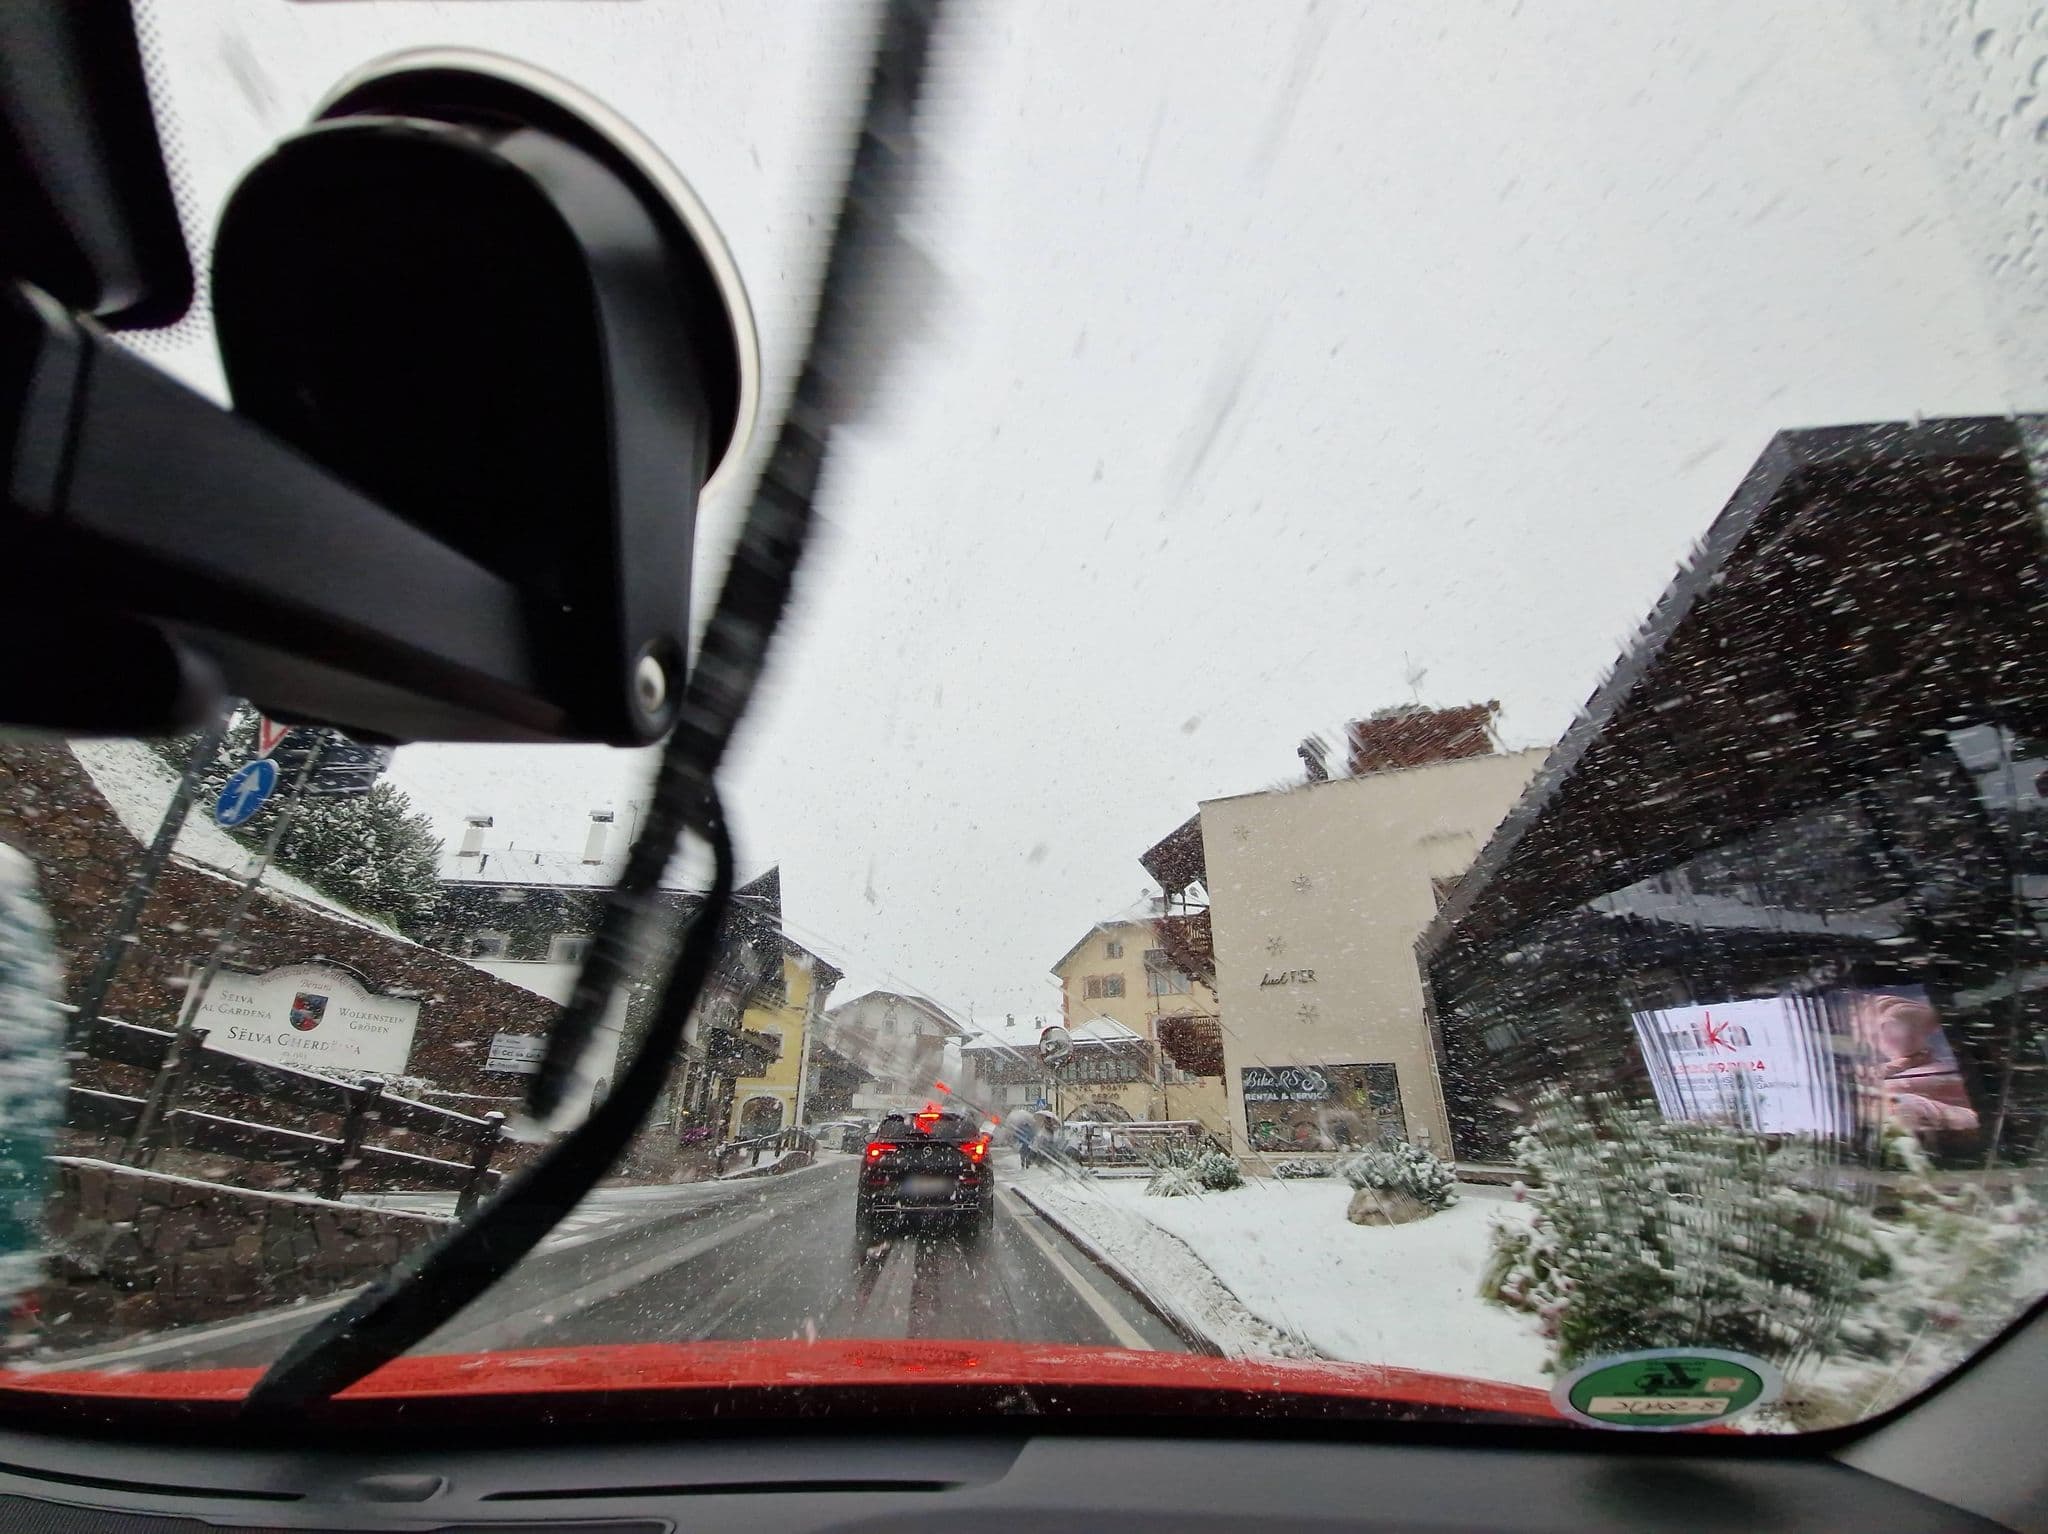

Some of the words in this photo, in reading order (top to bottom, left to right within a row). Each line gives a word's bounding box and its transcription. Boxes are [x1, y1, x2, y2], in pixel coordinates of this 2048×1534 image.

[221, 990, 254, 1004] SELVA
[218, 1003, 271, 1020] GARDENA
[339, 1007, 406, 1023] WOLKENSTEIN
[349, 1020, 390, 1033] GRÖDEN
[227, 1026, 272, 1044] SËLVA
[1245, 1092, 1280, 1101] RENTAL
